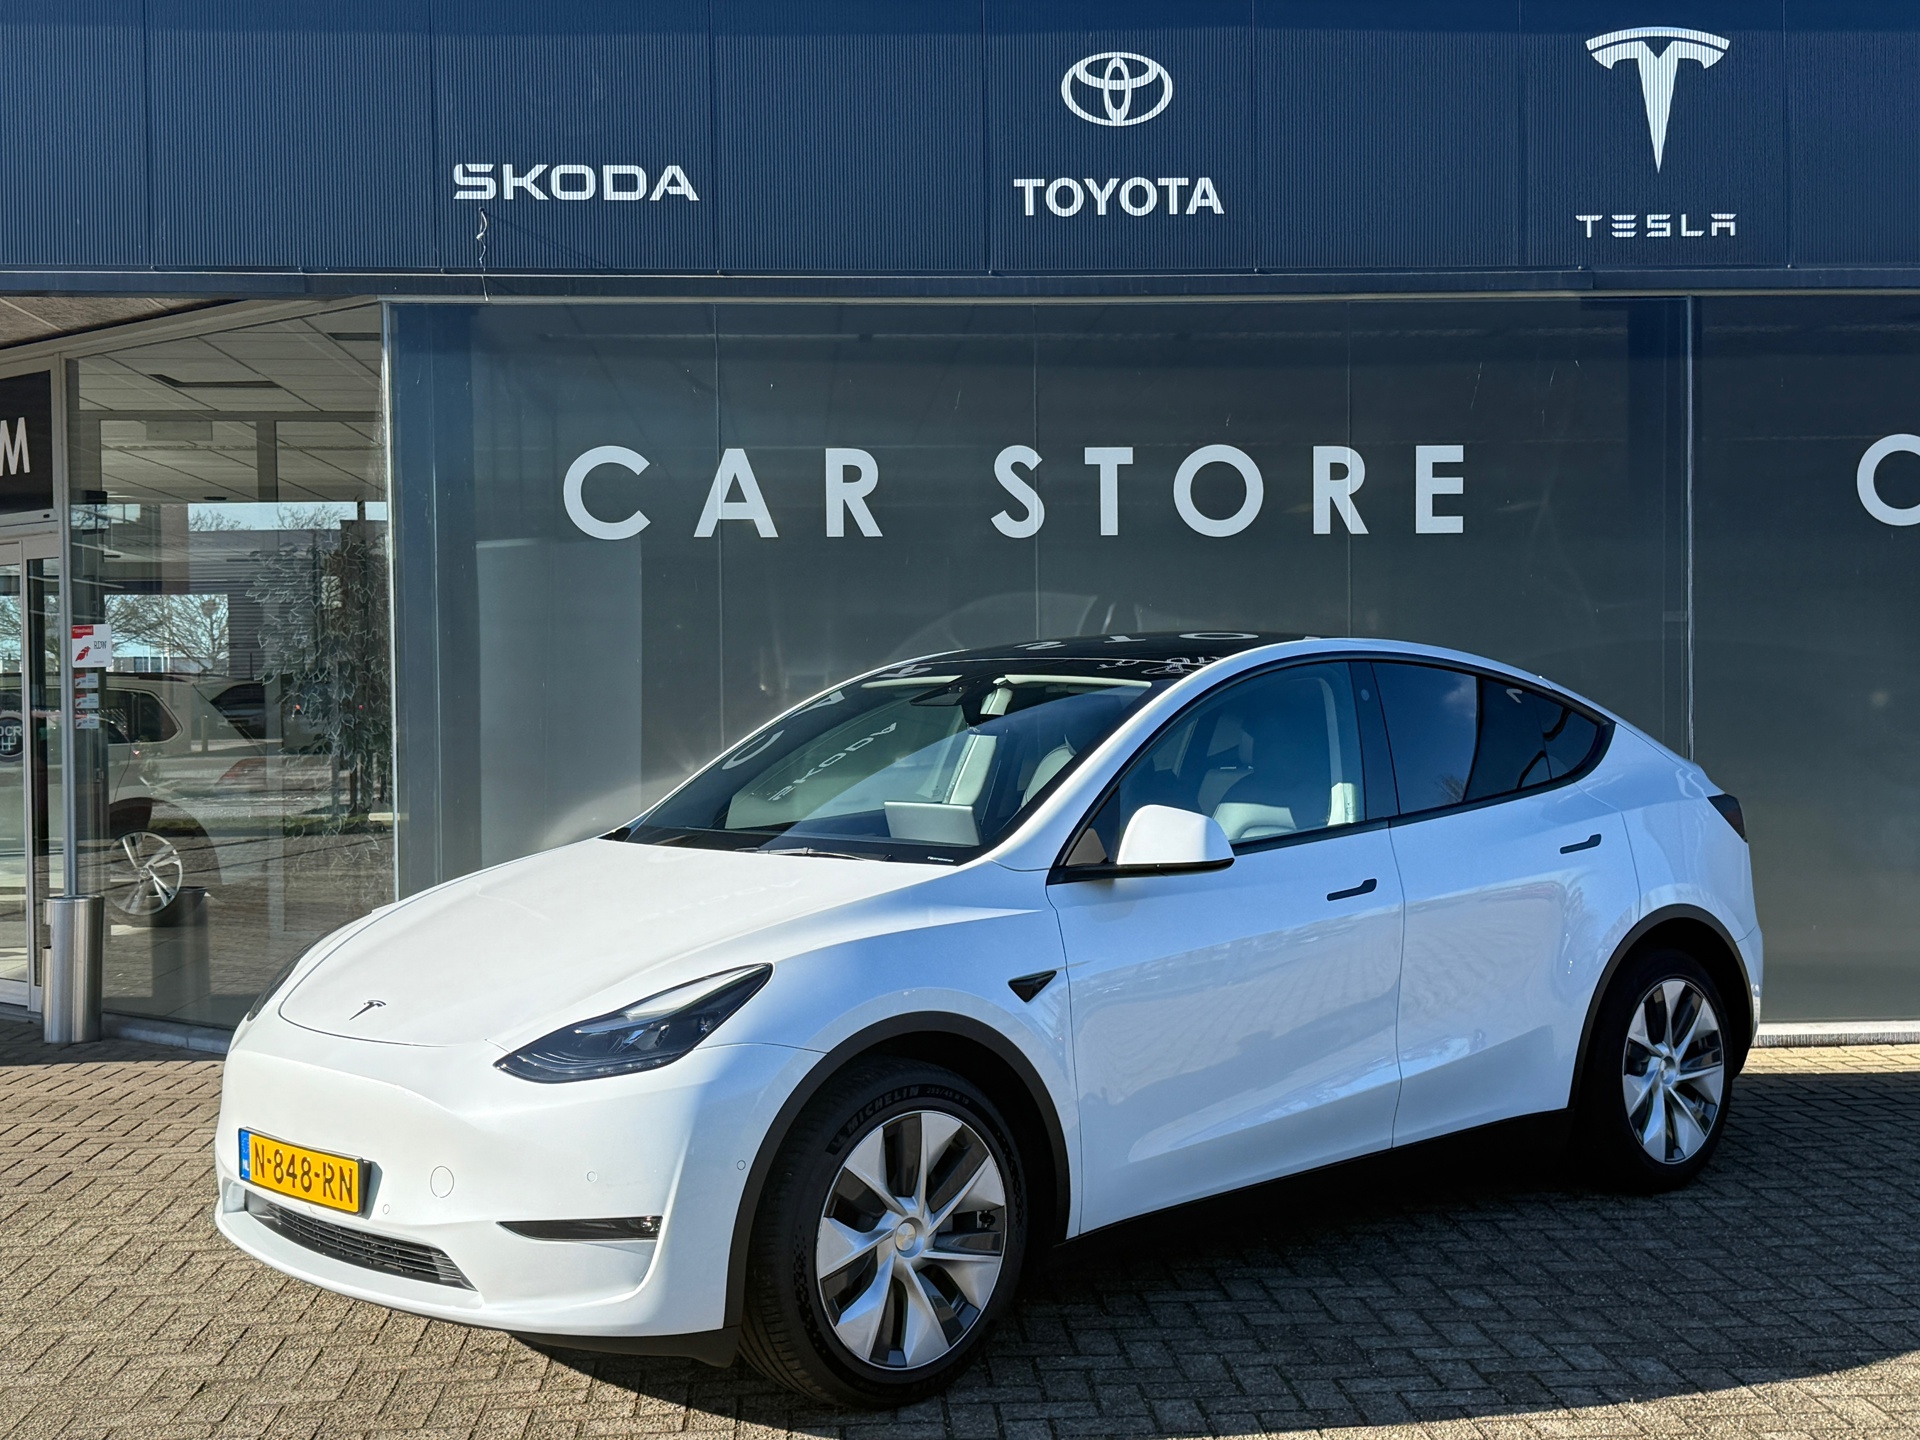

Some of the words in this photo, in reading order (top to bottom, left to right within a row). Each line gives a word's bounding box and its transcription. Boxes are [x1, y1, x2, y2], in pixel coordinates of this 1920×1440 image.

[453, 163, 700, 202] SKODA
[1014, 177, 1225, 218] TOYOTA
[1575, 213, 1738, 238] TESLA
[563, 445, 882, 540] CAR
[991, 444, 1465, 539] STORE
[846, 1085, 920, 1136] MICHELIN
[254, 1141, 353, 1204] N-848-RN
